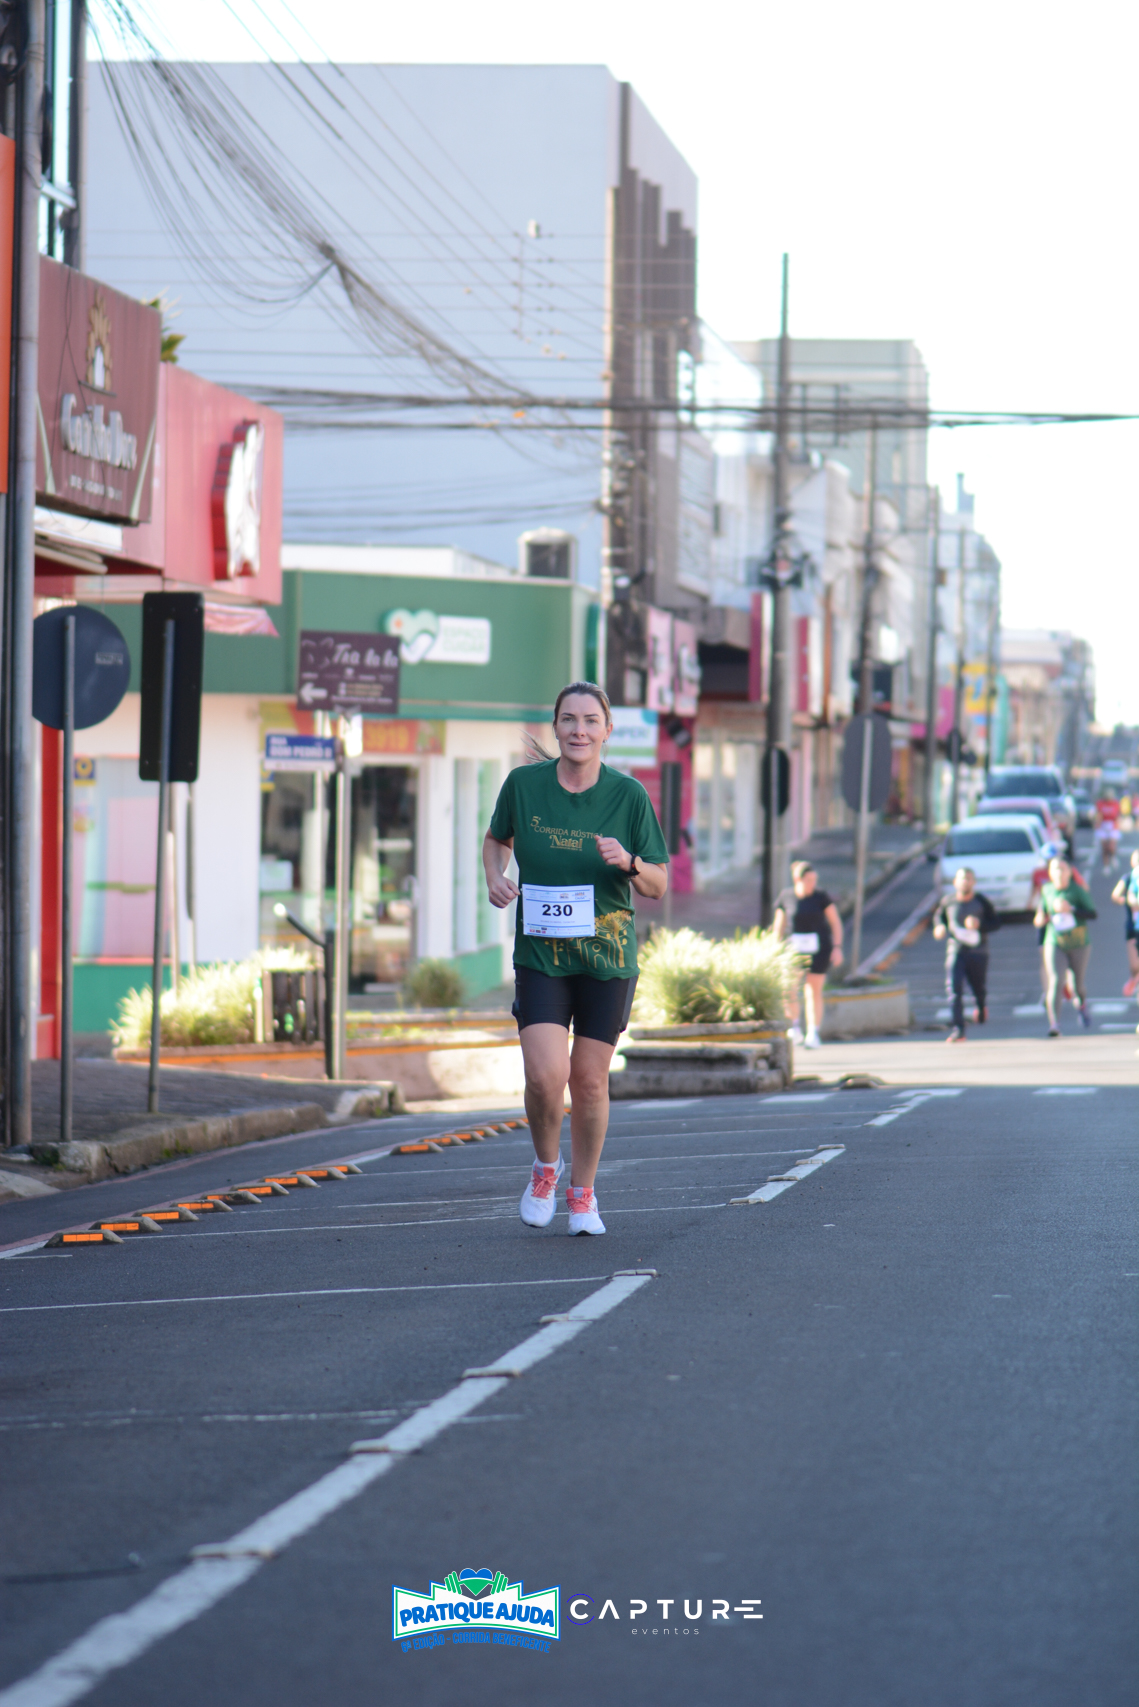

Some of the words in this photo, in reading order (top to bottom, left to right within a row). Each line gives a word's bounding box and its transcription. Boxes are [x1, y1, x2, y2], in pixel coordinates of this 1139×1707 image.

[332, 643, 360, 665] Tra
[365, 647, 381, 667] la
[383, 648, 398, 668] la
[293, 745, 323, 758] PEDRO
[534, 826, 569, 837] CORRIDA
[549, 835, 583, 849] Natal
[542, 903, 573, 917] 230
